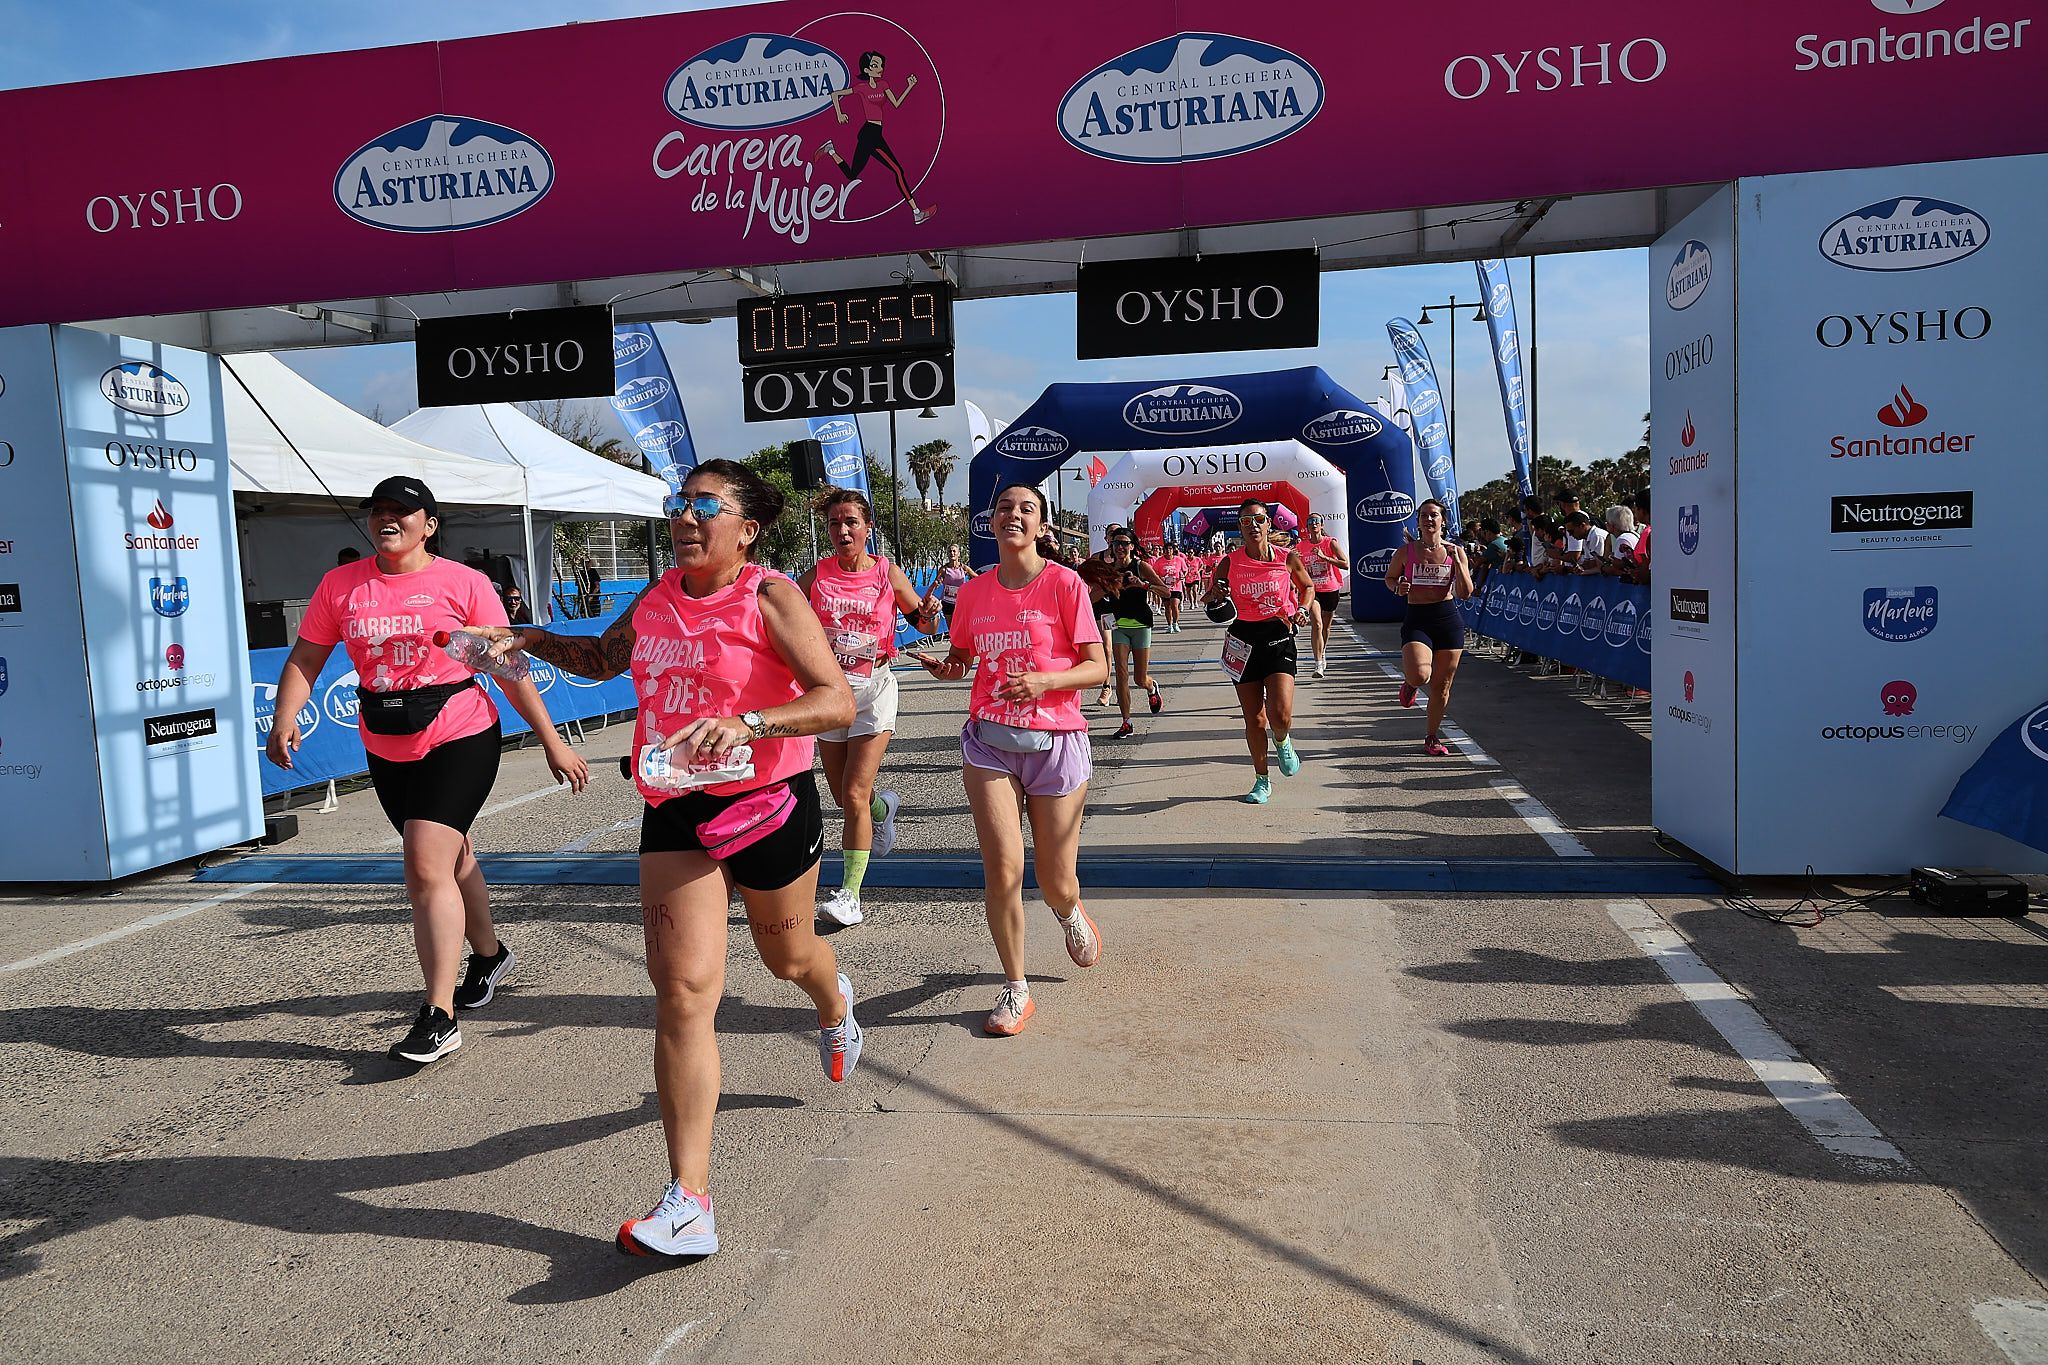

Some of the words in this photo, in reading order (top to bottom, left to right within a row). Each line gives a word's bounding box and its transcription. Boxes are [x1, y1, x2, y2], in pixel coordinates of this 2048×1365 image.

[1795, 17, 2032, 71] Santander
[705, 68, 764, 81] CENTRAL
[769, 59, 829, 75] LECHERA
[1445, 38, 1667, 99] OYSHO
[679, 74, 835, 112] ASTURIANA
[1117, 77, 1199, 98] CENTRAL
[1208, 68, 1293, 87] LECHERA
[1078, 87, 1303, 138] ASTURIANA
[382, 156, 450, 173] CENTRAL
[457, 148, 529, 166] LECHERA
[652, 131, 804, 180] Carrera
[352, 165, 538, 209] ASTURIANA
[86, 183, 243, 233] OYSHO
[691, 179, 719, 213] de
[725, 177, 746, 211] la
[743, 161, 862, 245] Mujer
[1858, 222, 1911, 233] CENTRAL
[1917, 218, 1972, 229] LECHERA
[1831, 228, 1977, 256] ASTURIANA
[1669, 263, 1708, 301] ASTURIANA
[1116, 285, 1284, 324] OYSHO
[753, 294, 934, 352] 00:35:59
[1816, 306, 1992, 348] OYSHO
[448, 340, 584, 380] OYSHO
[1665, 334, 1713, 381] OYSHO
[108, 377, 184, 406] ASTURIANA
[754, 360, 944, 413] OYSHO
[1133, 402, 1234, 424] ASTURIANA
[1150, 399, 1187, 407] CENTRAL
[1191, 397, 1229, 405] LECHERA
[1310, 423, 1377, 439] ASTURIANA
[105, 441, 197, 472] OYSHO
[1000, 439, 1063, 452] ASTURIANA
[1830, 432, 1975, 459] Santander
[1163, 452, 1267, 476] OYSHO
[1297, 470, 1329, 479] OYSHO
[1670, 449, 1709, 475] Santander
[1103, 482, 1134, 490] OYSHO
[1183, 486, 1212, 496] Sports
[1225, 482, 1272, 493] Santander
[1360, 504, 1412, 516] ASTURIANA
[1841, 503, 1962, 526] Neutrogena
[125, 533, 199, 550] Santander
[152, 586, 188, 607] Marlene
[1240, 581, 1280, 595] CARRERA
[1672, 595, 1706, 618] Neutrogena
[1868, 599, 1933, 628] Marlene
[349, 614, 424, 639] CARRERA
[1870, 626, 1884, 637] HIJA
[1909, 626, 1928, 638] ALPES
[393, 641, 416, 666] DE
[633, 635, 705, 669] CARRERA
[974, 630, 1033, 653] CARRERA
[136, 677, 182, 691] octopus
[182, 673, 216, 687] energy
[664, 675, 694, 714] DE
[150, 718, 212, 738] Neutrogena
[1822, 724, 1904, 743] octopus
[1907, 725, 1978, 744] energy
[643, 904, 674, 930] POR
